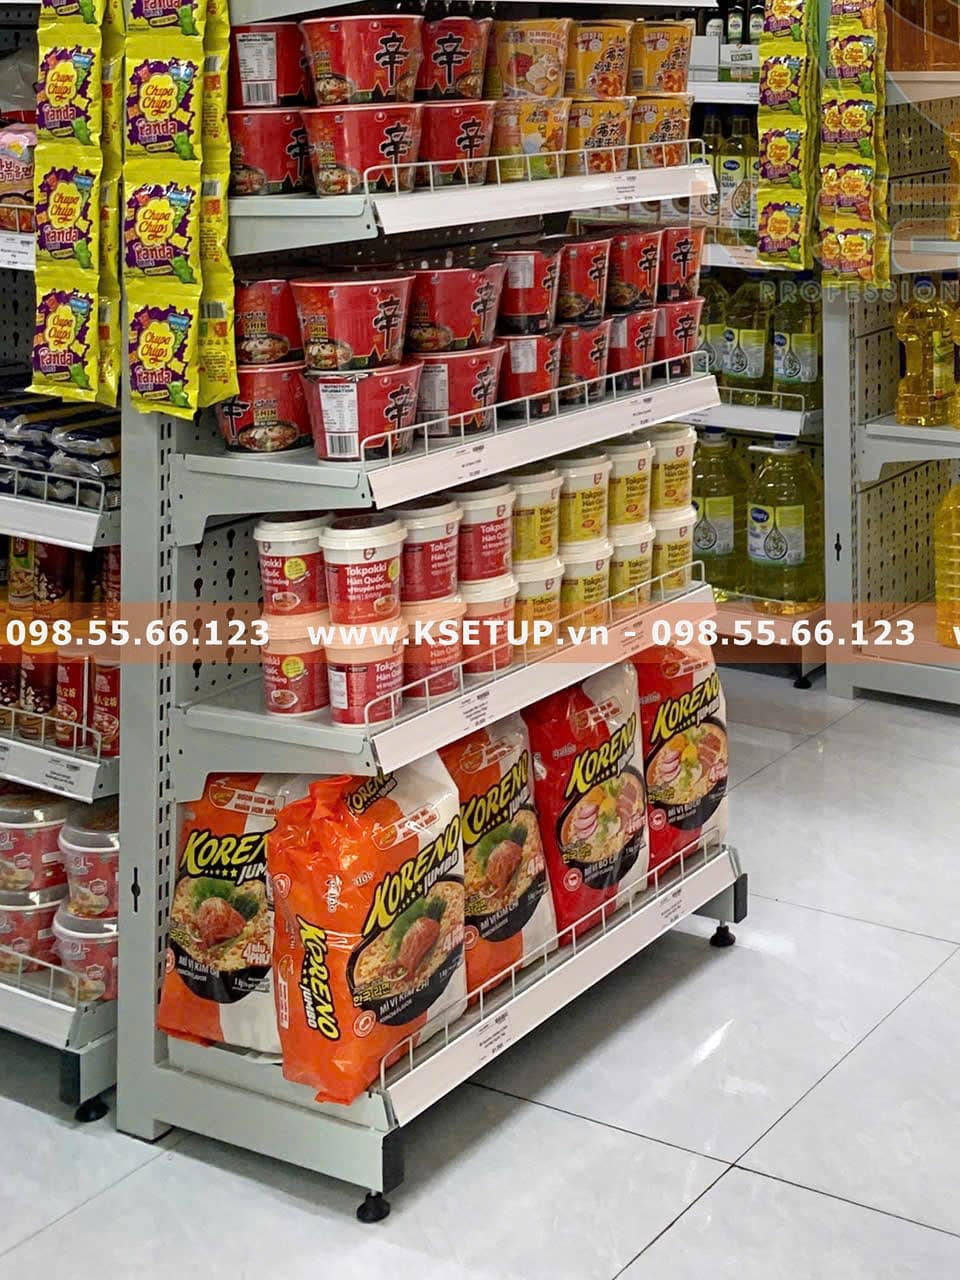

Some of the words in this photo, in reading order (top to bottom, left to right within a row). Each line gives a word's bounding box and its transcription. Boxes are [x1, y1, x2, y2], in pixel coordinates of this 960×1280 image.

[375, 31, 409, 89] 辛
[432, 32, 470, 89] 辛
[42, 103, 77, 121] Panda
[142, 95, 172, 111] Chups
[145, 85, 174, 98] Chupa
[137, 118, 178, 138] Panda
[379, 121, 412, 168] 辛
[456, 117, 486, 169] 辛
[43, 225, 78, 243] Panda
[133, 243, 173, 262] Panda
[589, 252, 607, 296] 辛
[639, 245, 658, 288] 辛
[672, 238, 694, 279] 辛
[373, 295, 402, 352] 辛
[472, 282, 497, 334] 辛
[635, 322, 655, 366] 辛
[674, 314, 698, 354] 辛
[39, 348, 74, 367] Panda
[136, 366, 172, 384] Panda
[472, 365, 497, 414] 辛
[384, 385, 416, 440] 辛
[345, 562, 387, 577] Tokpokki
[346, 576, 363, 586] Hàn
[363, 575, 384, 585] Quốc
[651, 670, 720, 744] KORENO
[565, 712, 636, 800] KORENO
[461, 750, 529, 846] KORENO
[179, 818, 278, 876] KORE
[236, 862, 268, 886] JUM
[362, 814, 461, 937] KORENO
[423, 847, 460, 898] JUMBO
[296, 914, 340, 1042] KORENO
[299, 983, 319, 1030] JUMBO
